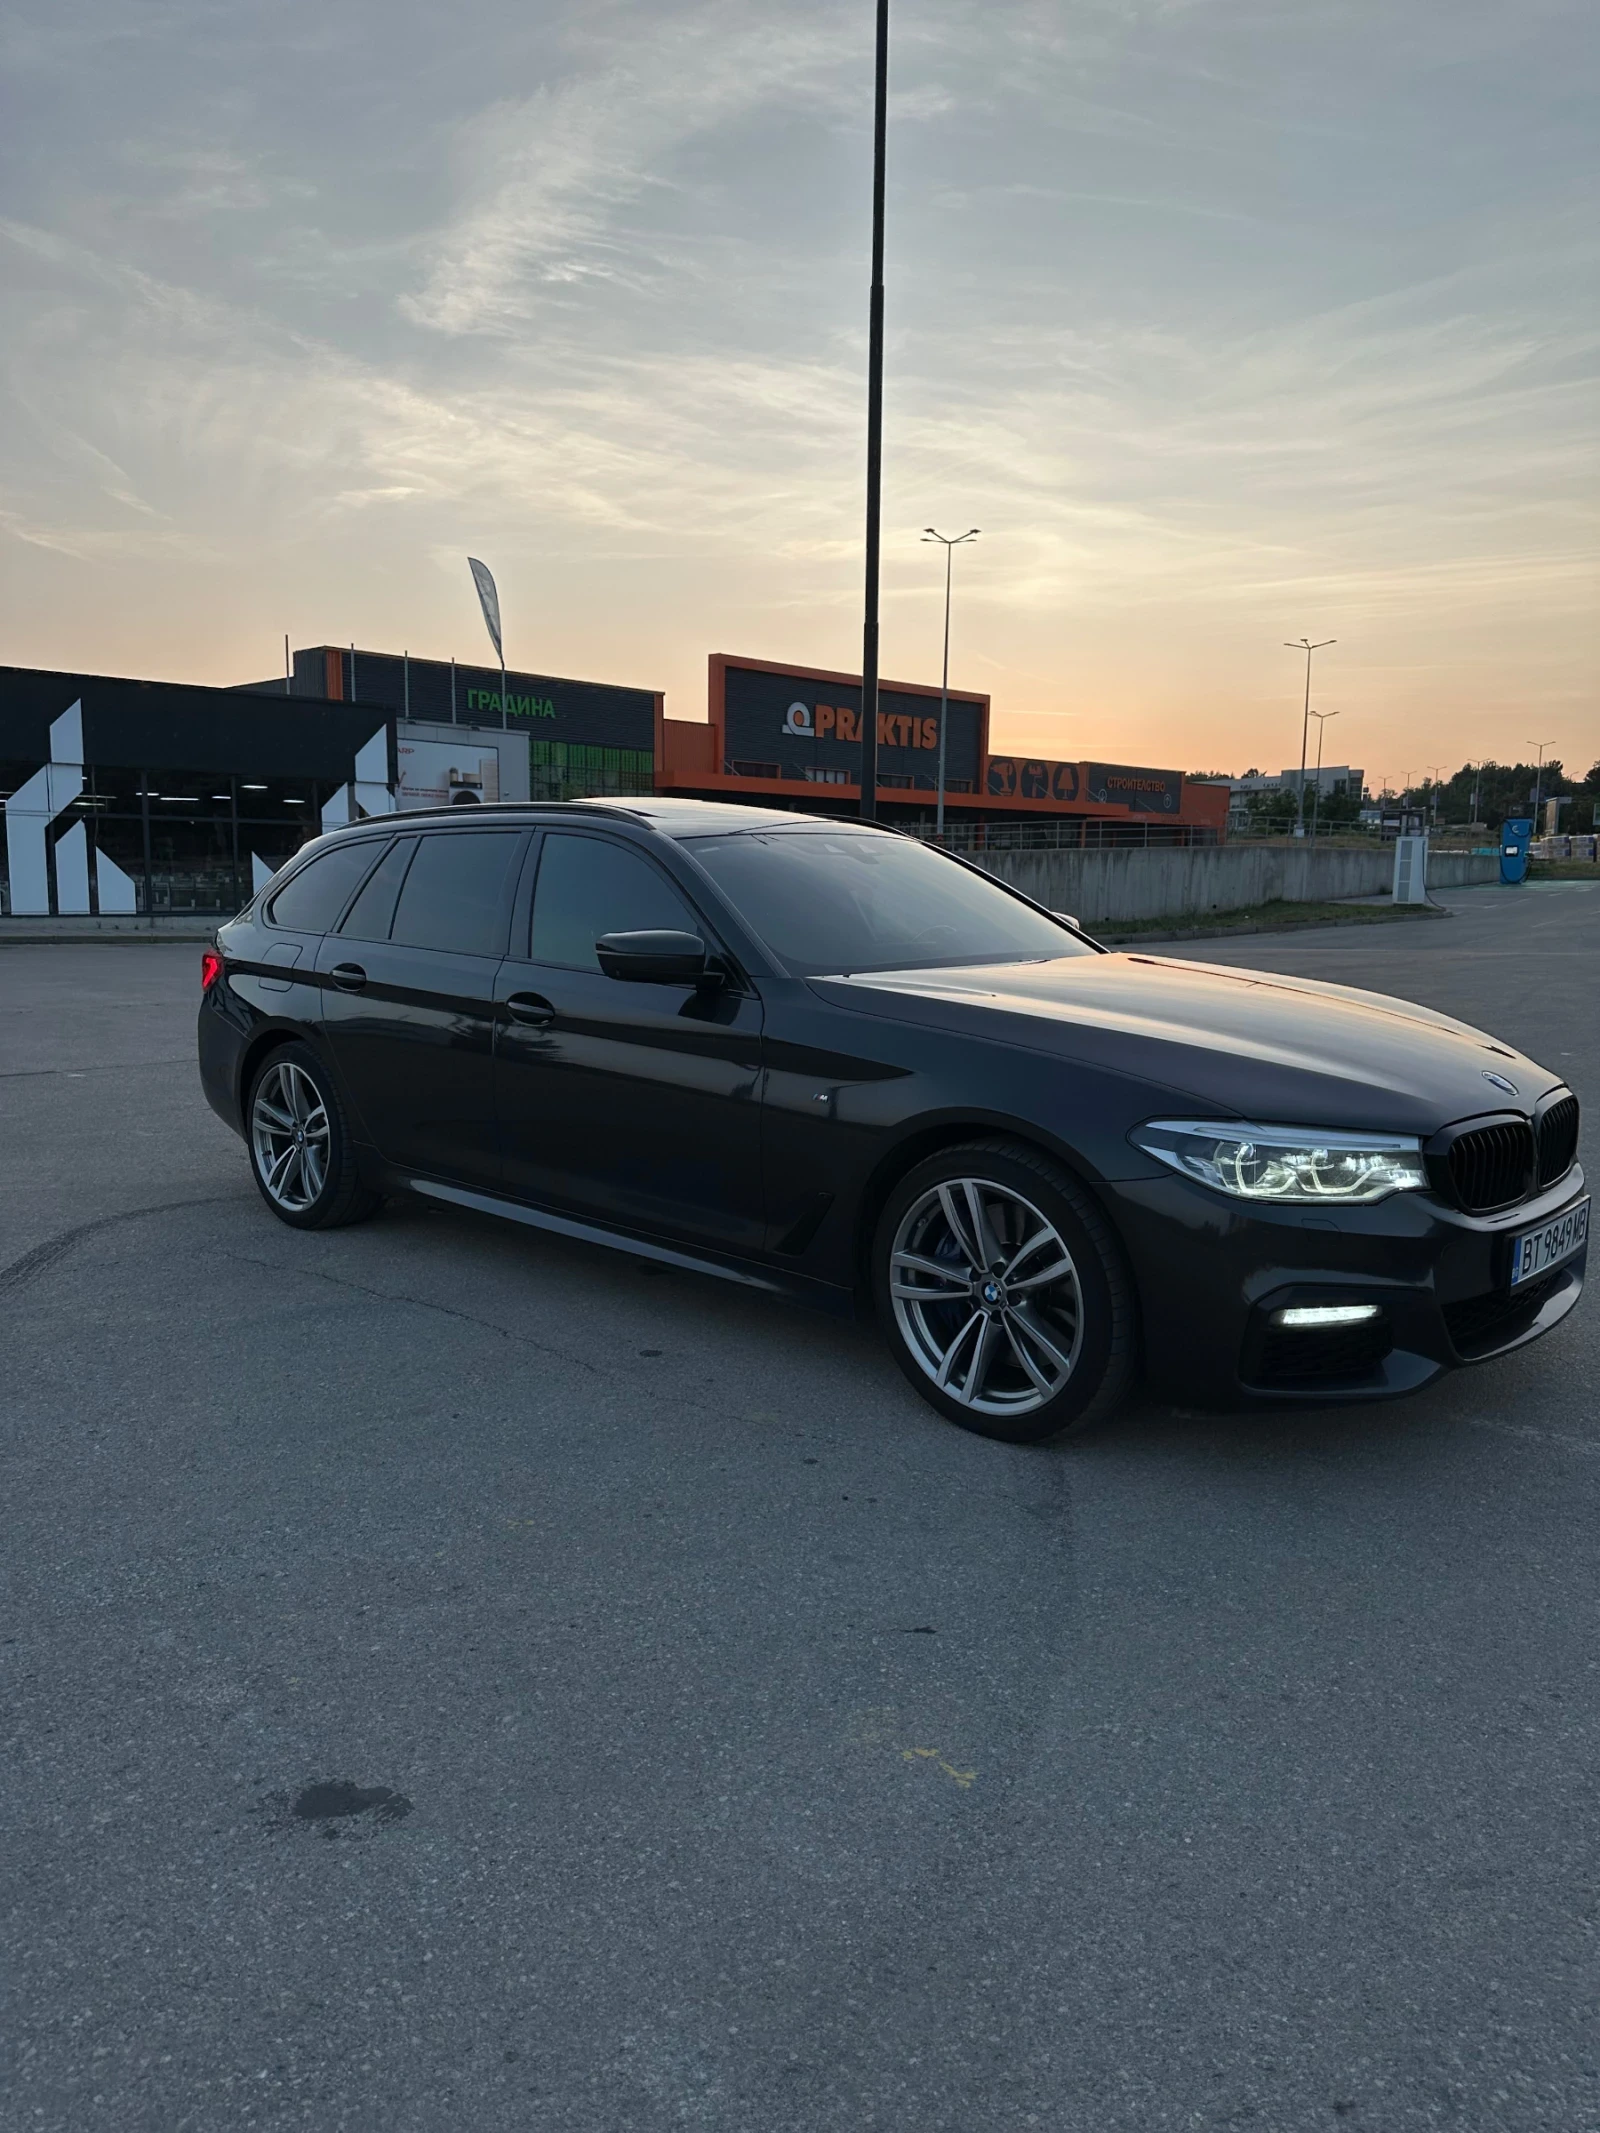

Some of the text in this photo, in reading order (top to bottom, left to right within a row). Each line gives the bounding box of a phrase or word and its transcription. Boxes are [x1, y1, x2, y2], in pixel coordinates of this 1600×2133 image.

[467, 689, 555, 718] ГРАДИНА
[397, 747, 415, 755] ARP
[1107, 776, 1166, 793] СТРОИТЕЛСТВО
[1522, 1207, 1587, 1275] BT 9849 MB
